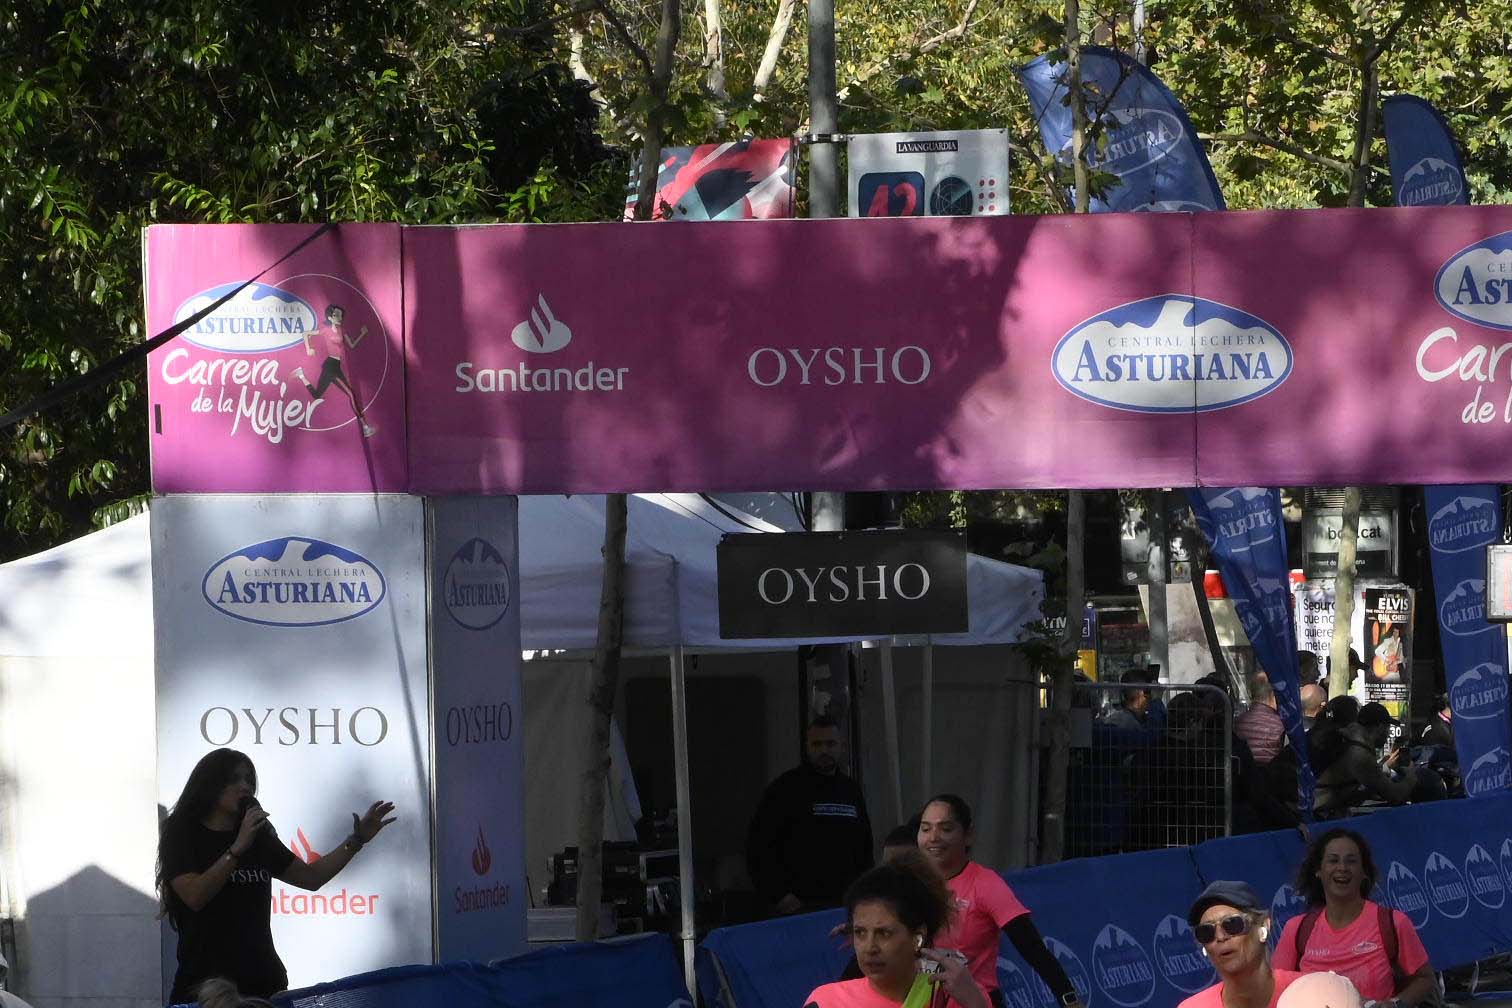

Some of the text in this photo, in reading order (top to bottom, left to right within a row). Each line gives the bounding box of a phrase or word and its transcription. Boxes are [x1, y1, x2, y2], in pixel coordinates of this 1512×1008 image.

[1107, 335, 1266, 348] CENTRAL LECHERA
[162, 348, 280, 385] Carrera
[455, 361, 629, 393] Santander
[747, 345, 931, 387] OYSHO
[1072, 338, 1274, 384] ASTURIANA
[191, 383, 325, 444] de la Mujer
[1462, 386, 1496, 426] de
[216, 570, 373, 605] ASTURIANA
[244, 567, 366, 577] CENTRAL LECHERA
[758, 563, 930, 605] OYSHO
[1304, 615, 1319, 625] que
[1379, 598, 1409, 611] ELVIS
[200, 706, 389, 747] OYSHO
[446, 702, 513, 747] OYSHO
[1389, 726, 1402, 738] 30
[229, 868, 270, 885] YSHO
[271, 888, 379, 916] ntander
